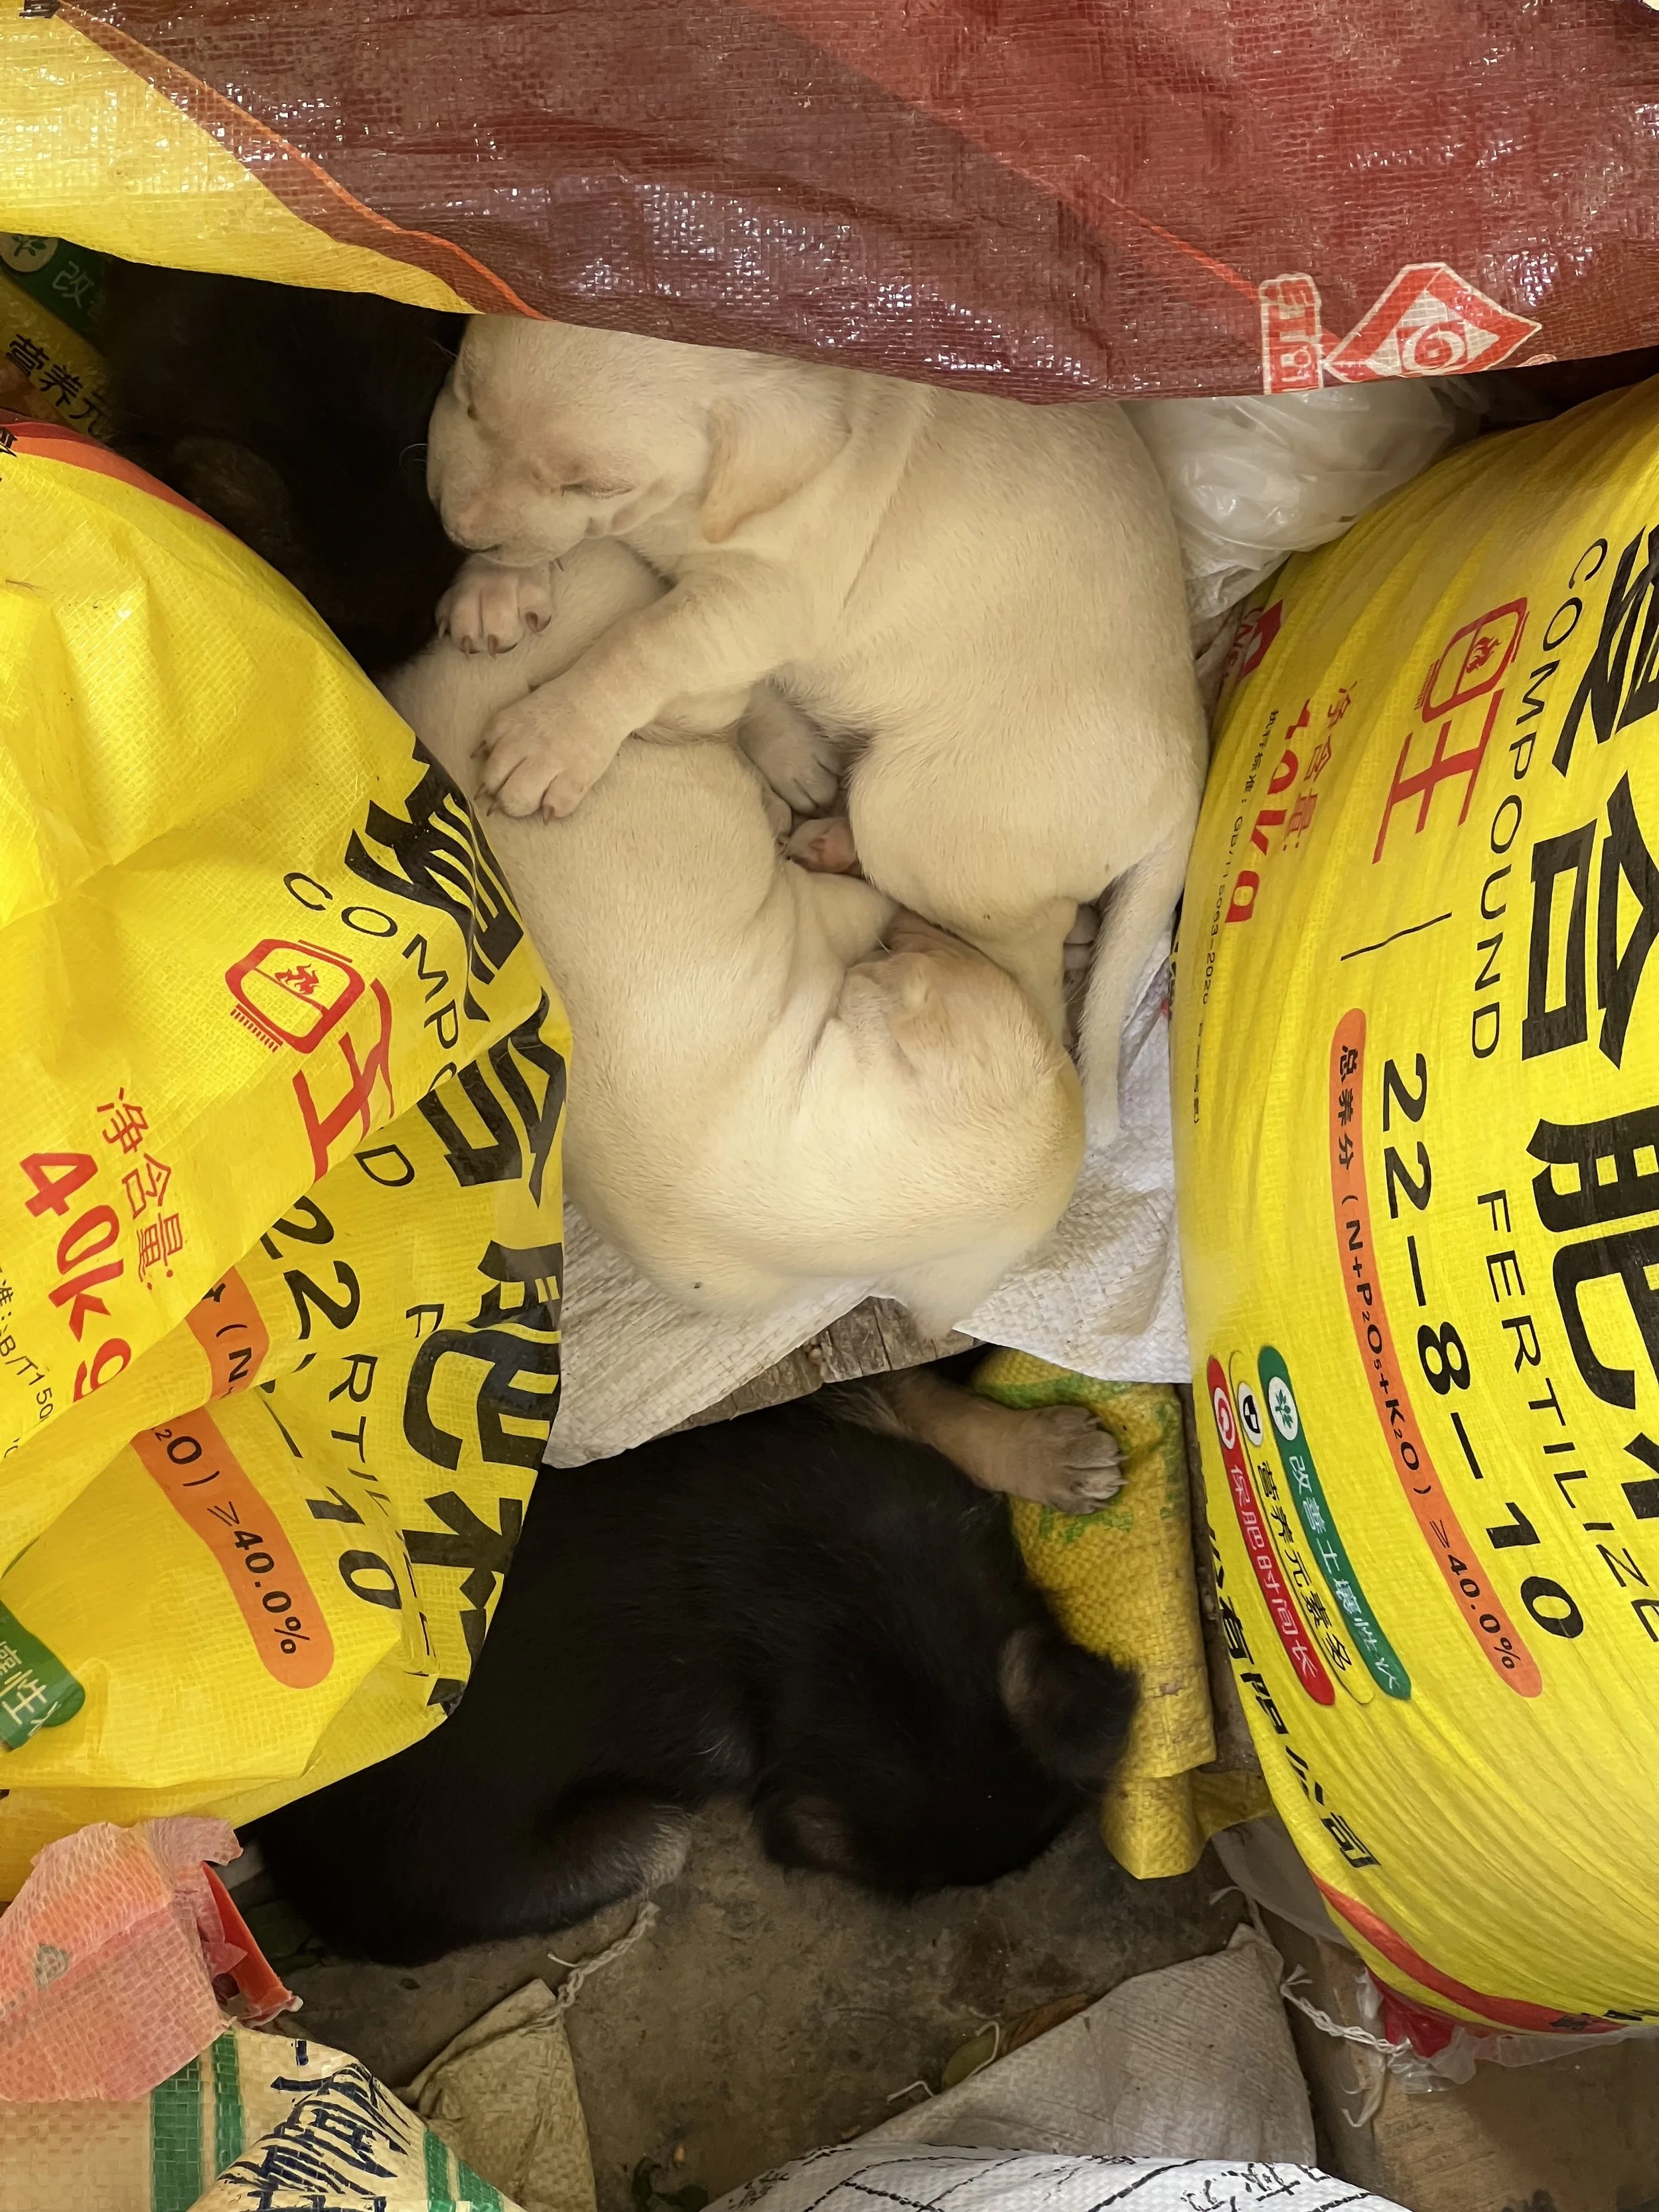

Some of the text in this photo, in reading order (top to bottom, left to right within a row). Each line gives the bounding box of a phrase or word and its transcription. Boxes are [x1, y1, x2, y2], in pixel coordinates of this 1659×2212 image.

[1471, 538, 1608, 1060] COMPOUND
[1230, 1465, 1318, 1680] 保肥时间长
[1257, 1460, 1352, 1672] 营养元素多
